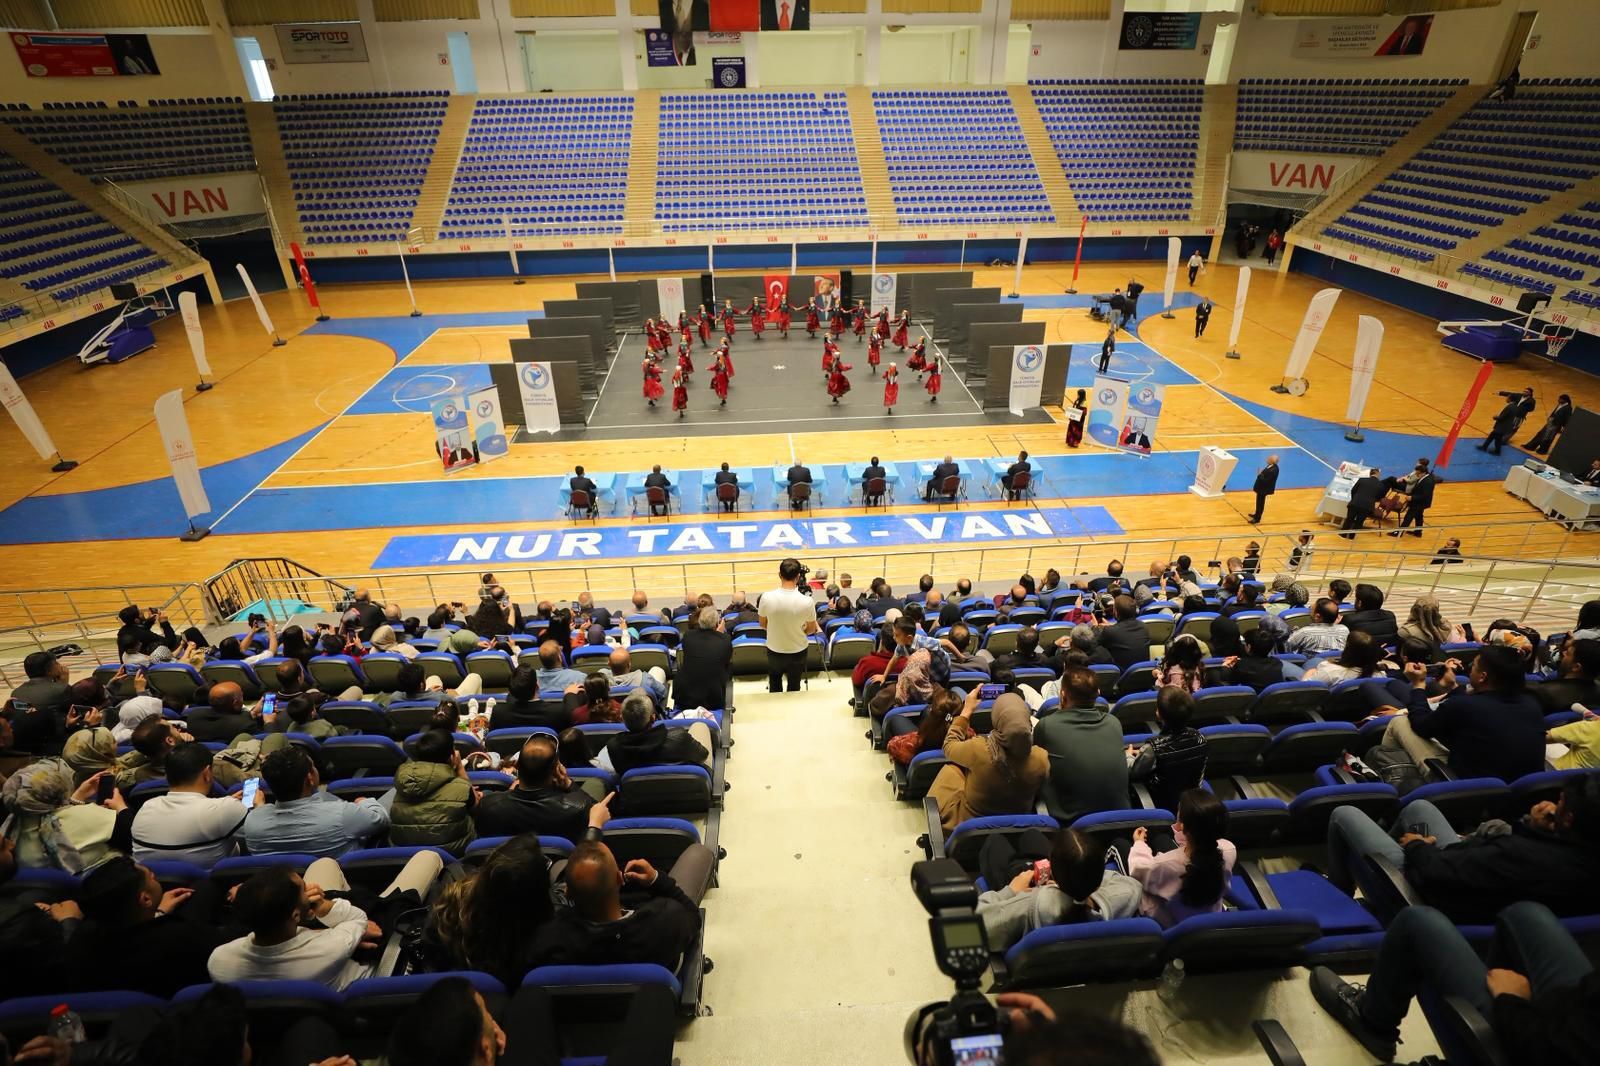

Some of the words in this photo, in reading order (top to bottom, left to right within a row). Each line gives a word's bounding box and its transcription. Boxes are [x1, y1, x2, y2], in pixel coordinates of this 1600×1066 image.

[291, 32, 349, 42] SPORTOTO
[1270, 162, 1336, 191] VAN
[152, 187, 229, 218] VAN
[447, 532, 601, 561] NUR
[628, 522, 857, 553] TATAR
[903, 512, 1053, 539] VAN
